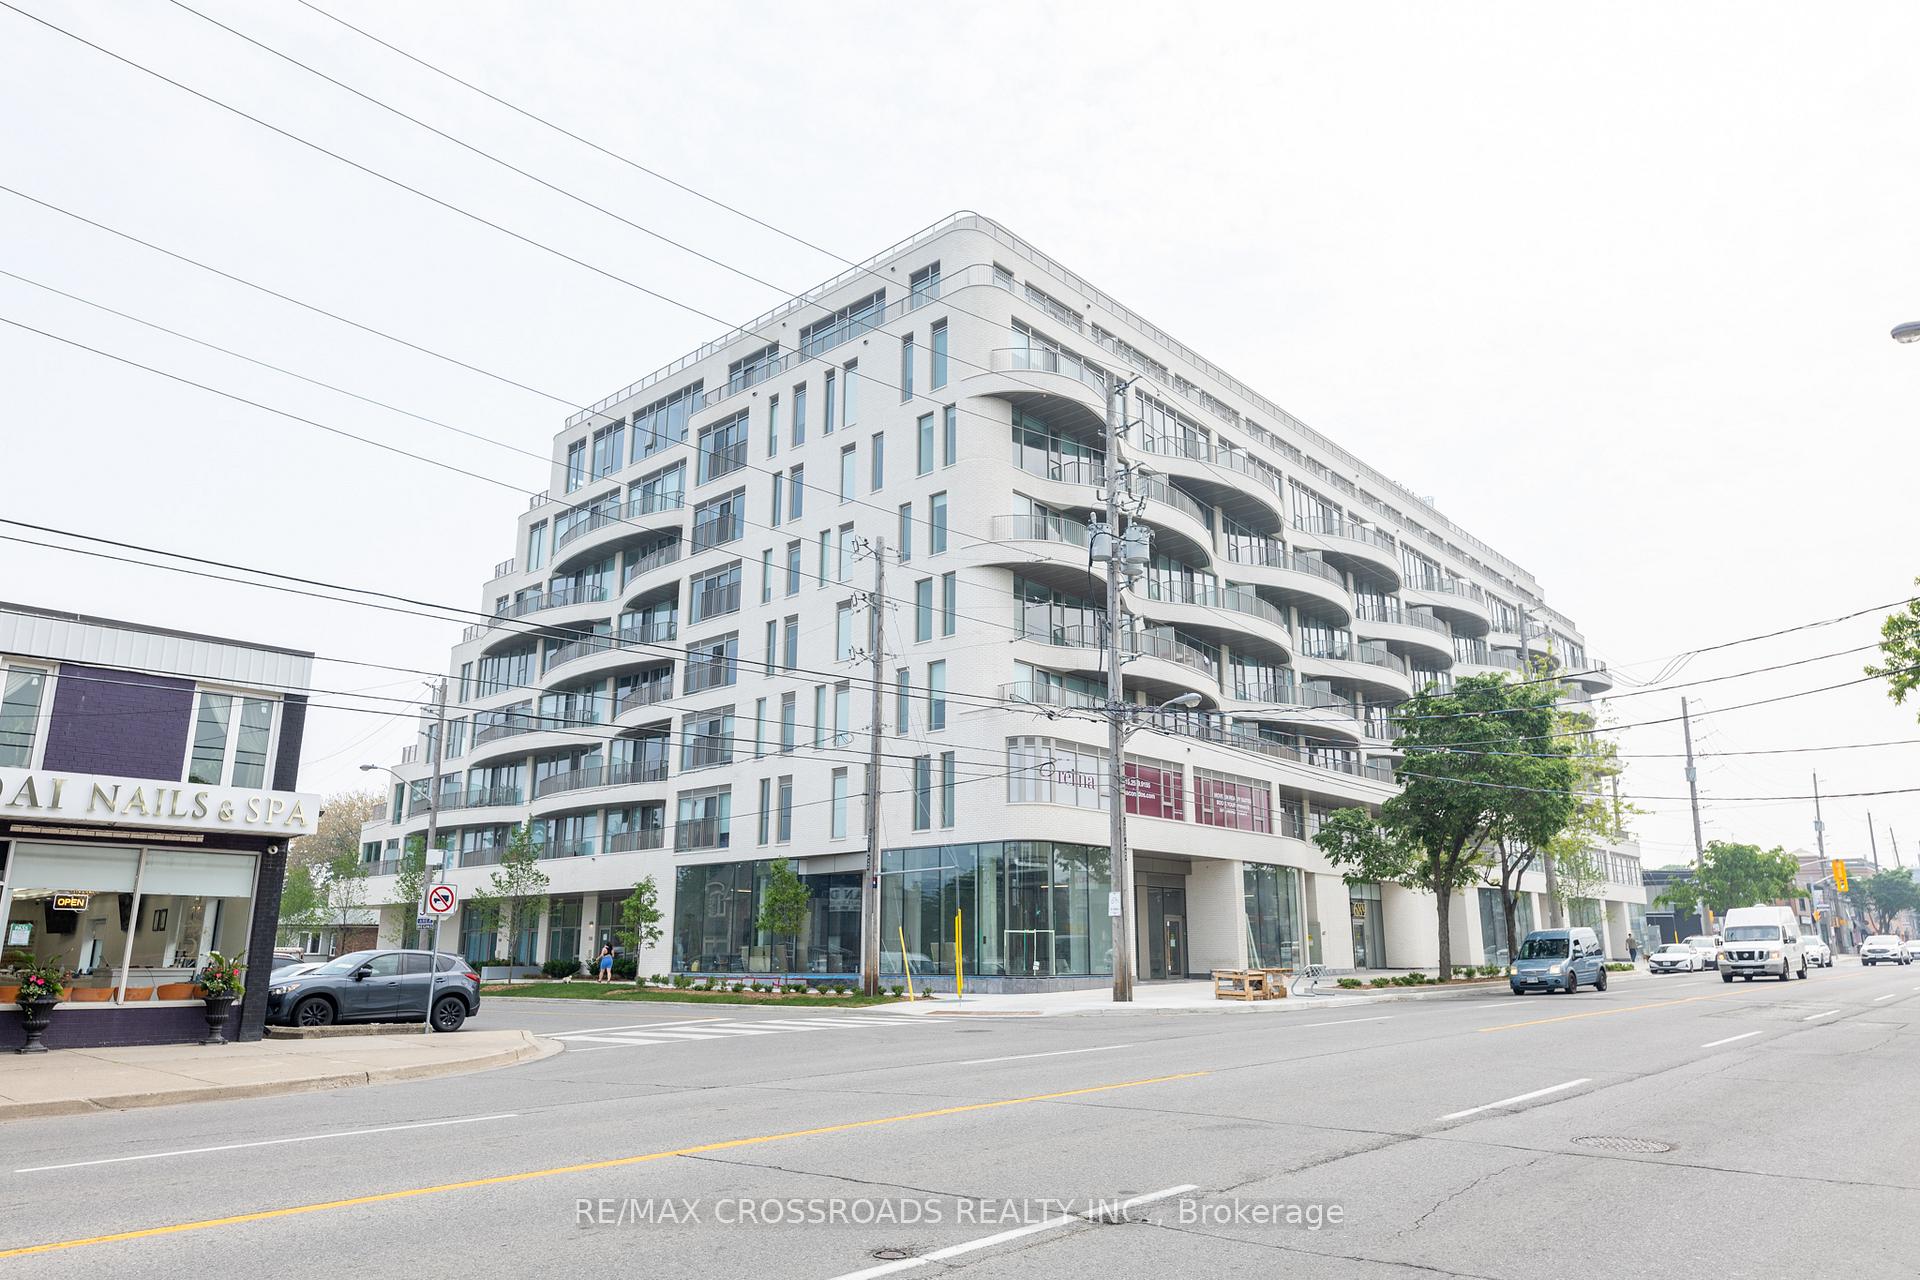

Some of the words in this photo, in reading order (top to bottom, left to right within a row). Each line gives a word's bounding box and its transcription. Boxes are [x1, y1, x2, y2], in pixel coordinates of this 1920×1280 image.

[1058, 768, 1096, 790] reina
[0, 775, 67, 810] AI
[86, 782, 208, 819] NAILS
[217, 799, 235, 822] &
[245, 795, 309, 827] SPA
[57, 898, 85, 907] OPEN
